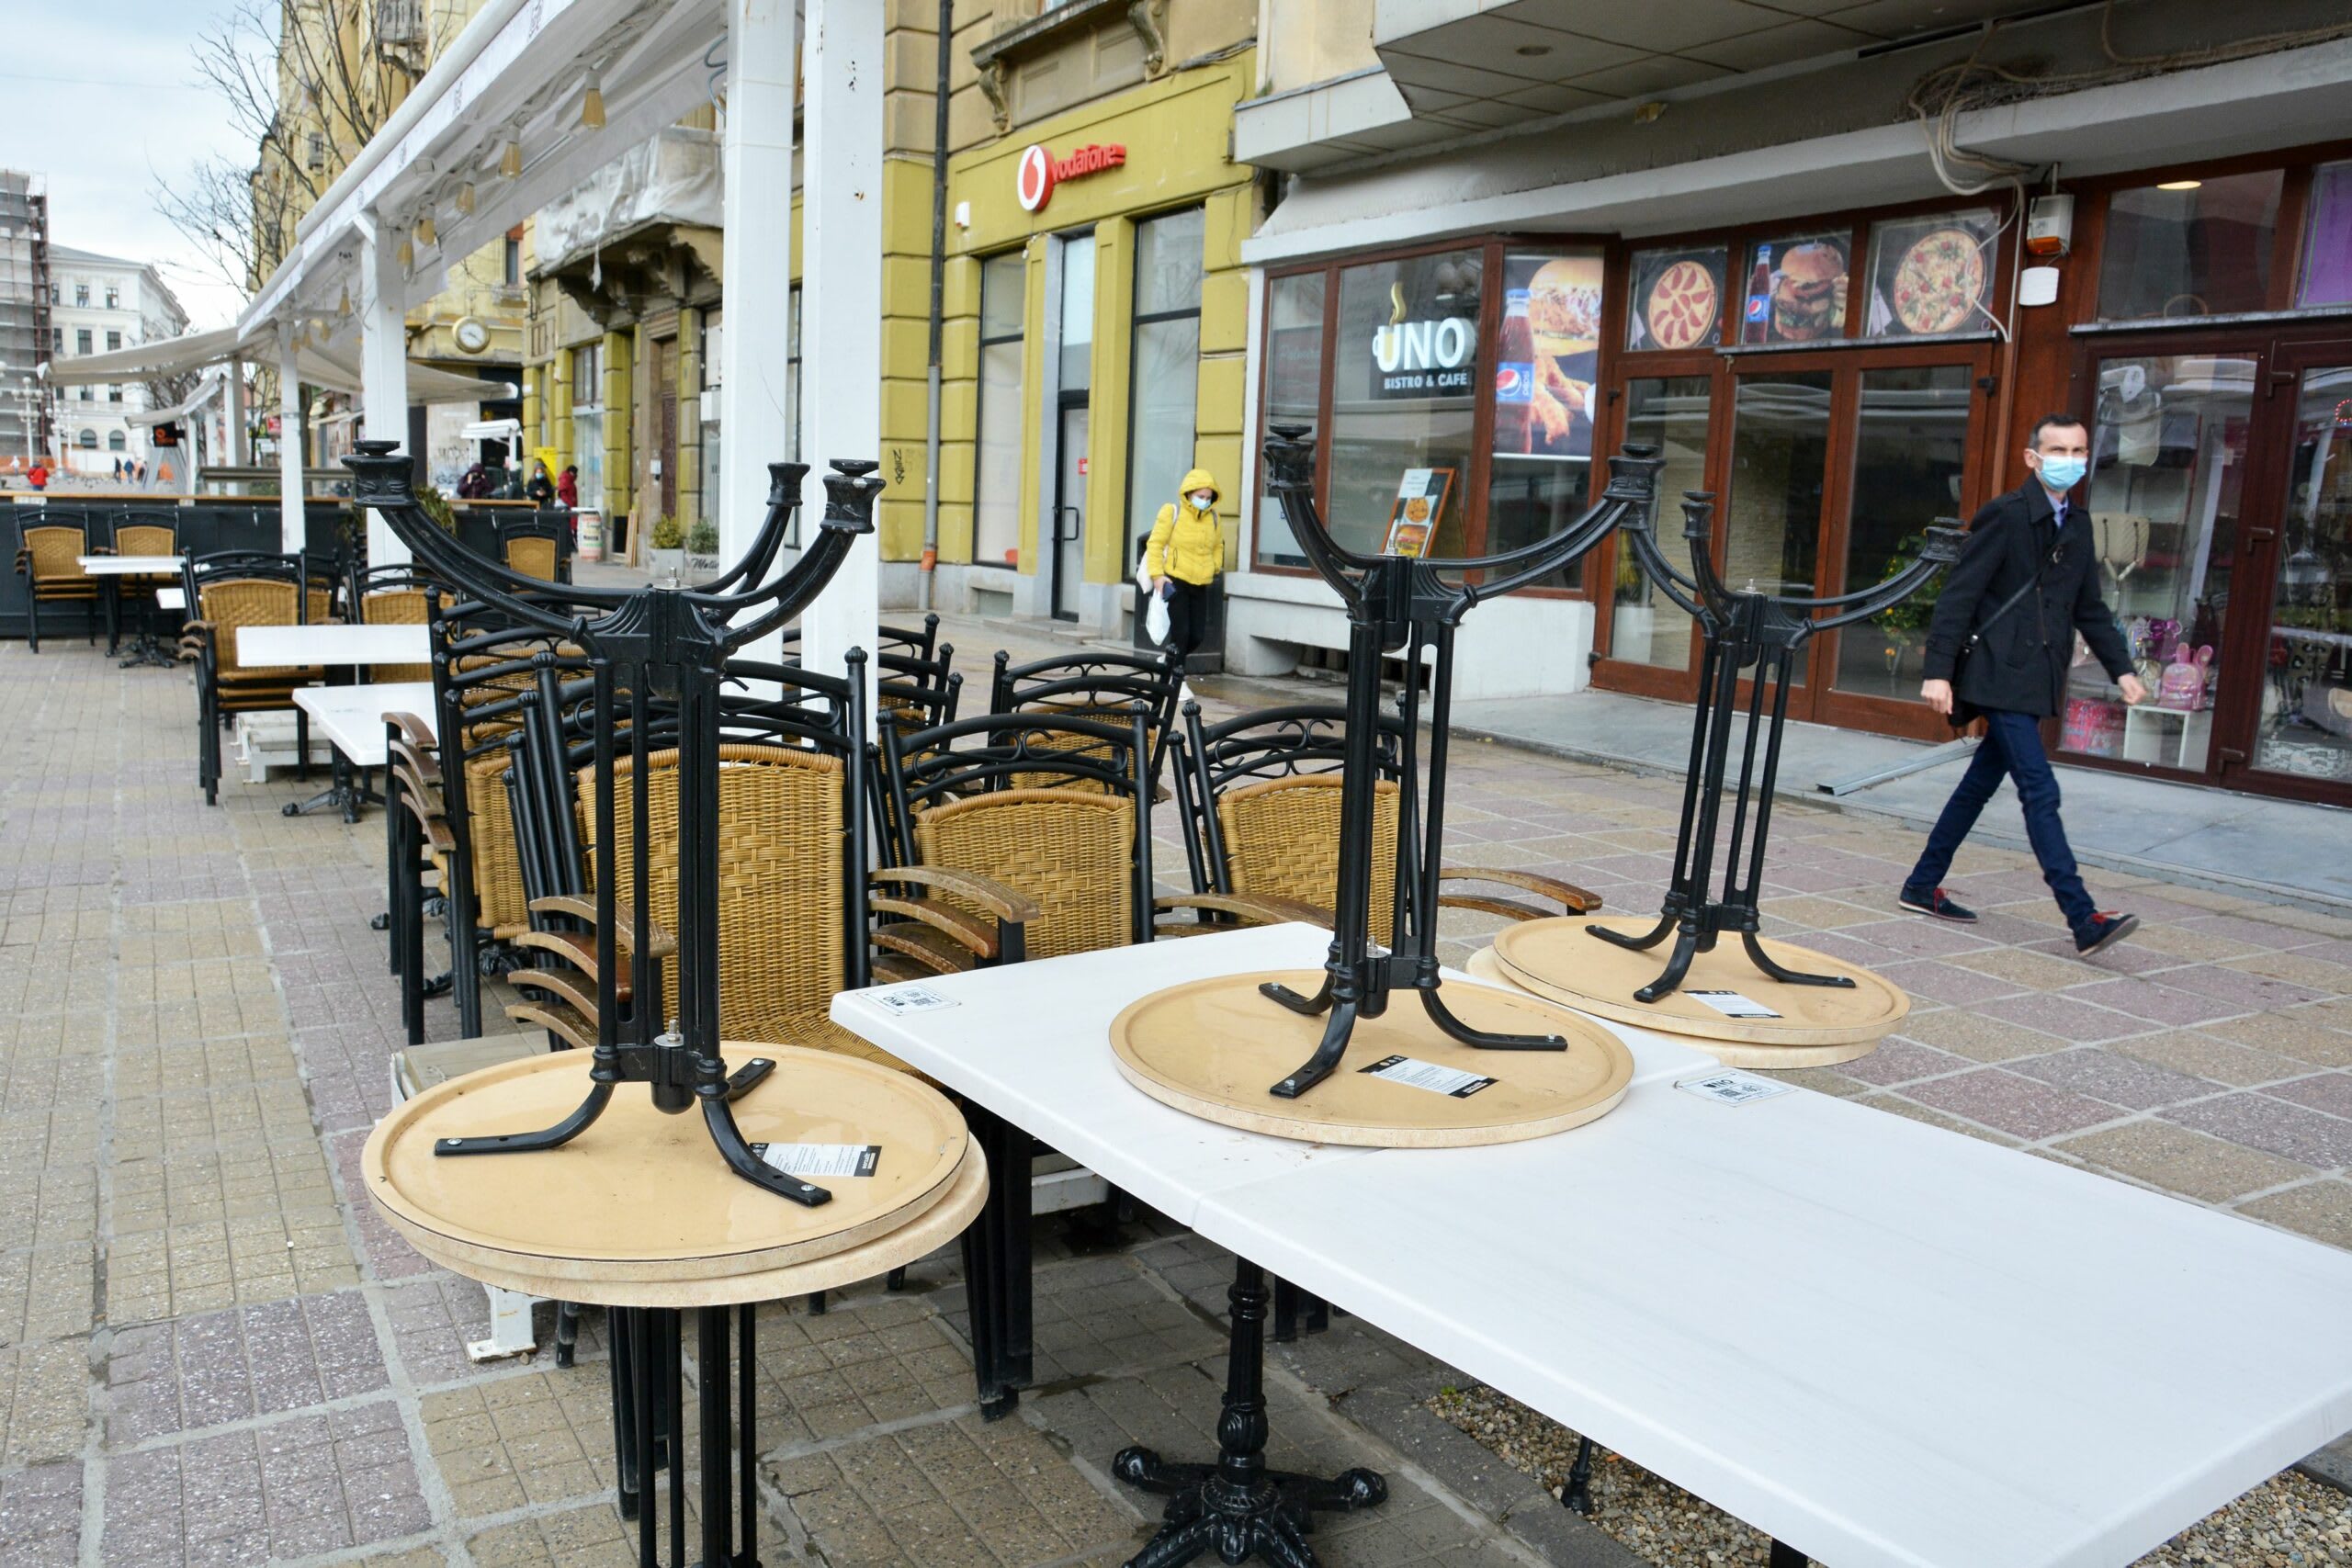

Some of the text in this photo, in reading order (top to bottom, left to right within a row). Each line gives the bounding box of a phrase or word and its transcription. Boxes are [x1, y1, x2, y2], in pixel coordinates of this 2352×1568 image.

[1052, 144, 1125, 183] vodafone
[1374, 317, 1467, 372] UNO
[1384, 369, 1468, 389] BISTRO & CAFÉ
